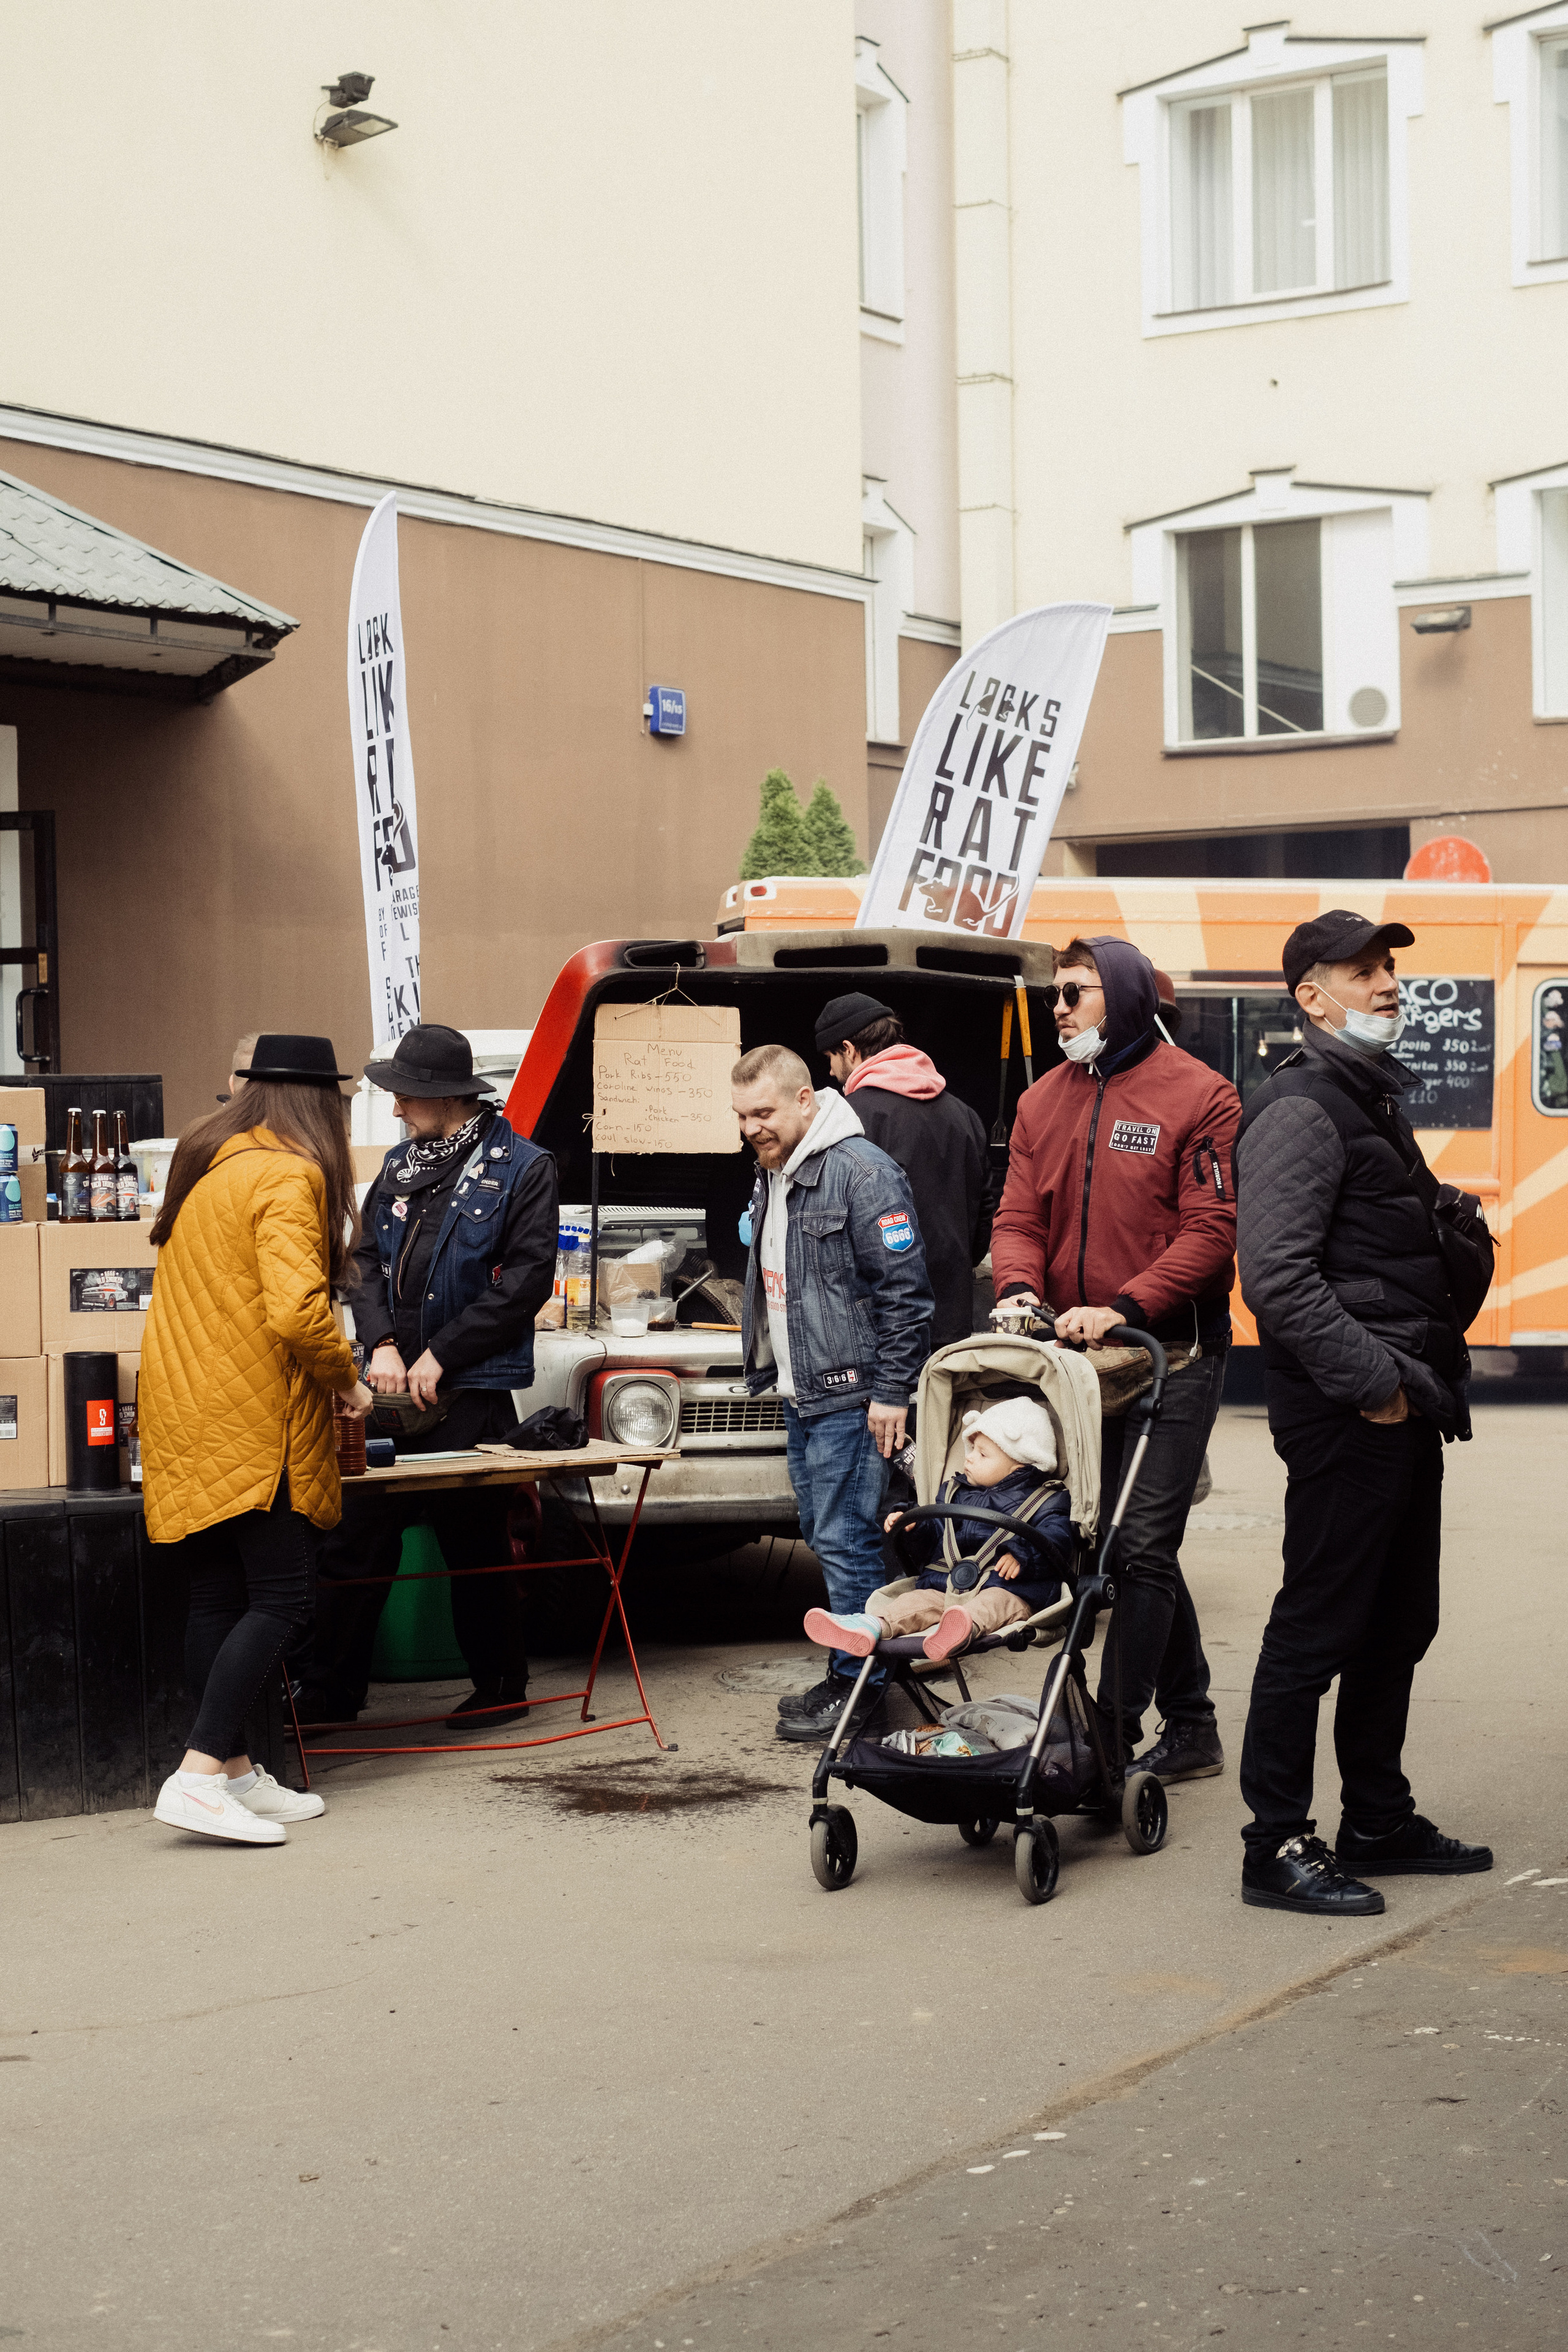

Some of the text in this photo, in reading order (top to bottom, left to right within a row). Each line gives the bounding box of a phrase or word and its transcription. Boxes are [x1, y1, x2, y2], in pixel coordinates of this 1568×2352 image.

[959, 671, 1061, 738] LOOKS
[935, 714, 1051, 807] LIKE
[920, 781, 1036, 872] RAT
[898, 849, 1019, 938] FOOD
[647, 1043, 682, 1057] Menu
[1442, 1038, 1469, 1054] 350
[624, 1053, 696, 1070] Rat Food
[1444, 1059, 1467, 1072] 350
[598, 1065, 621, 1079] Pork
[631, 1069, 652, 1080] Ribs
[1446, 1075, 1469, 1088] 400
[596, 1122, 623, 1131] Corn
[1117, 1124, 1144, 1133] TRAVEL
[1114, 1133, 1155, 1145] GO FAST
[881, 1215, 906, 1227] ROAD CREW
[885, 1227, 911, 1245] 6666
